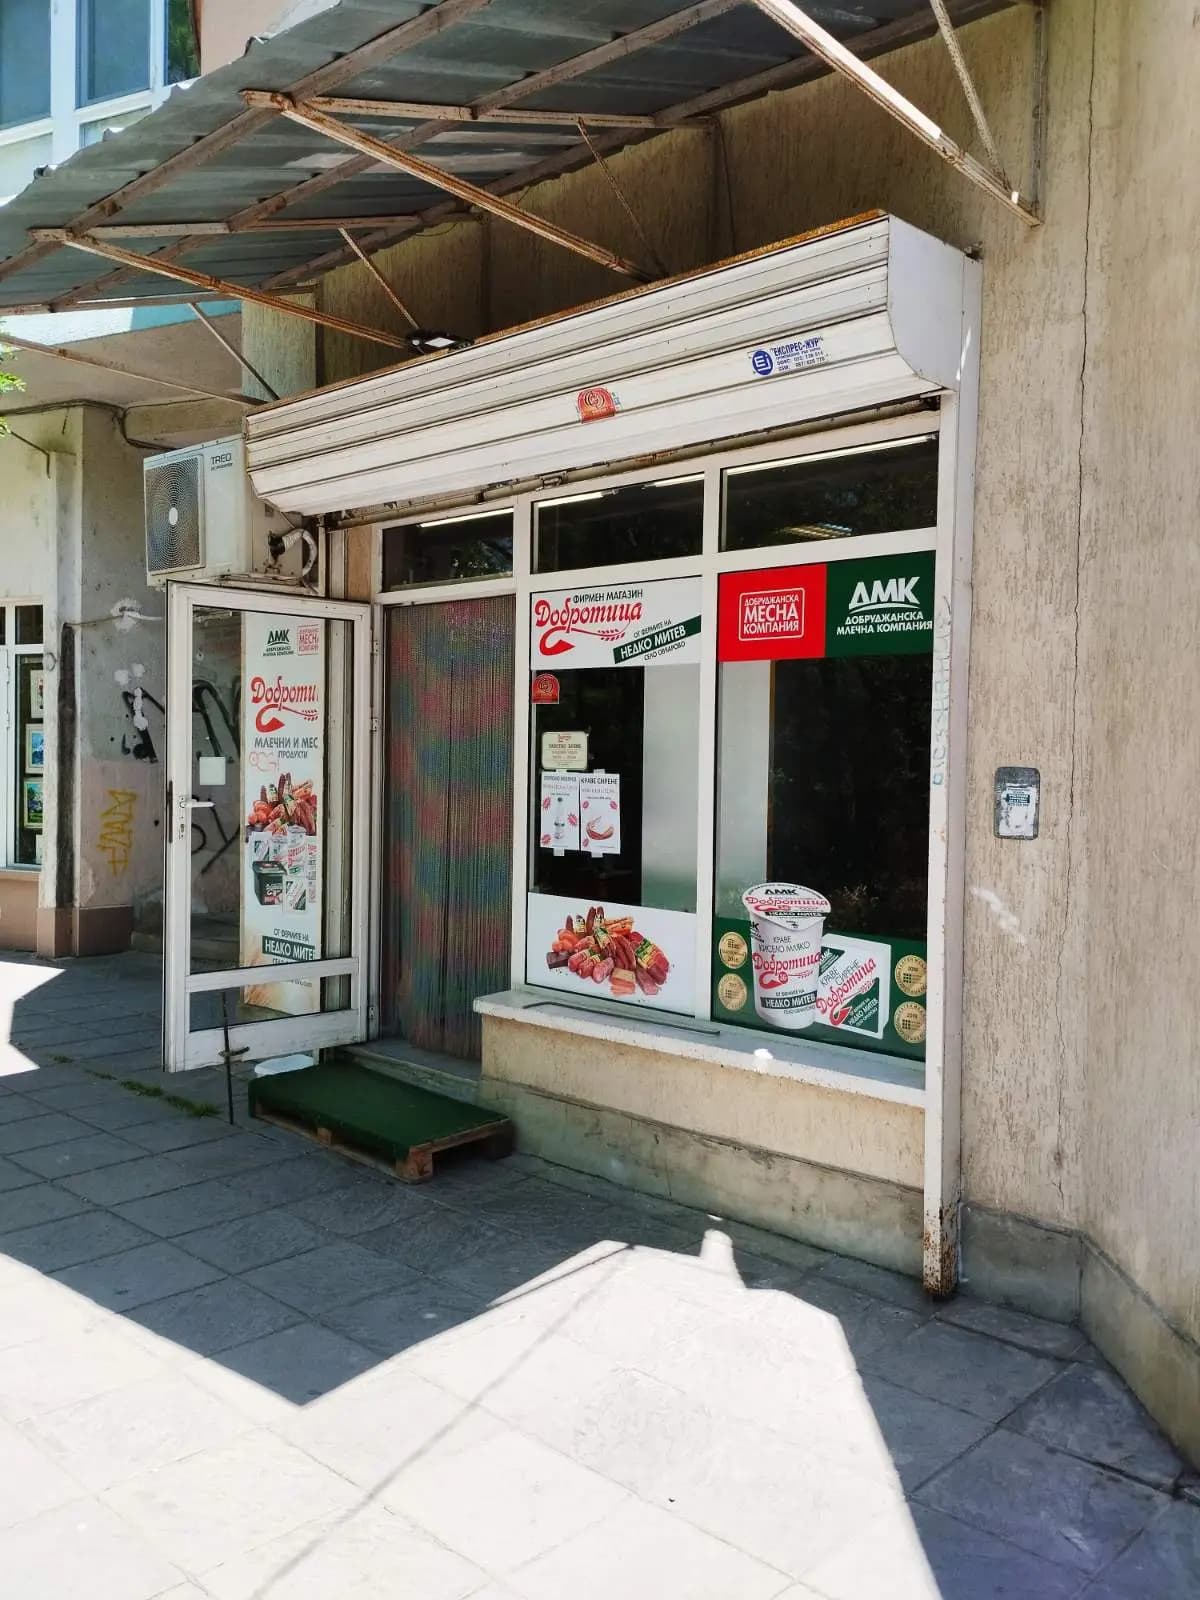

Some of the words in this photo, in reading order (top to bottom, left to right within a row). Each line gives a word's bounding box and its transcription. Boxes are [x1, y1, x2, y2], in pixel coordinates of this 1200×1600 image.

[573, 592, 605, 604] ФИРМЕН
[606, 589, 643, 601] МАГАЗИН
[848, 576, 920, 609] ДМК
[744, 594, 799, 607] ДОБРУДЖАНСКА
[534, 597, 642, 634] Добротица
[744, 604, 799, 624] МЕСНА
[845, 611, 924, 625] ДОБРУДЖАНСКА
[743, 621, 799, 635] КОМПАНИЯ
[836, 622, 875, 636] МЛЕЧНА
[876, 620, 933, 633] КОМПАНИЯ
[299, 633, 319, 645] МЕСН
[620, 638, 651, 660] НЕДКО
[654, 625, 686, 647] МИТЕВ
[250, 675, 319, 712] Доброти
[254, 736, 291, 749] МЛЕЧНИ
[293, 736, 299, 748] И
[301, 736, 318, 748] МЕС
[278, 750, 308, 759] ПРОДУКТИ
[745, 896, 828, 907] Добротица
[759, 943, 785, 953] КИСЕЛО
[786, 941, 811, 953] МЛЯКО
[773, 935, 792, 944] КРАВЕ
[265, 939, 291, 956] НЕДКО
[752, 952, 821, 976] Добротица
[819, 966, 840, 986] КРАВЕ
[835, 959, 861, 986] СИРЕНЕ
[816, 958, 877, 1014] Добротица
[765, 998, 791, 1008] НЕДКО
[791, 993, 816, 1007] МИТЕВ
